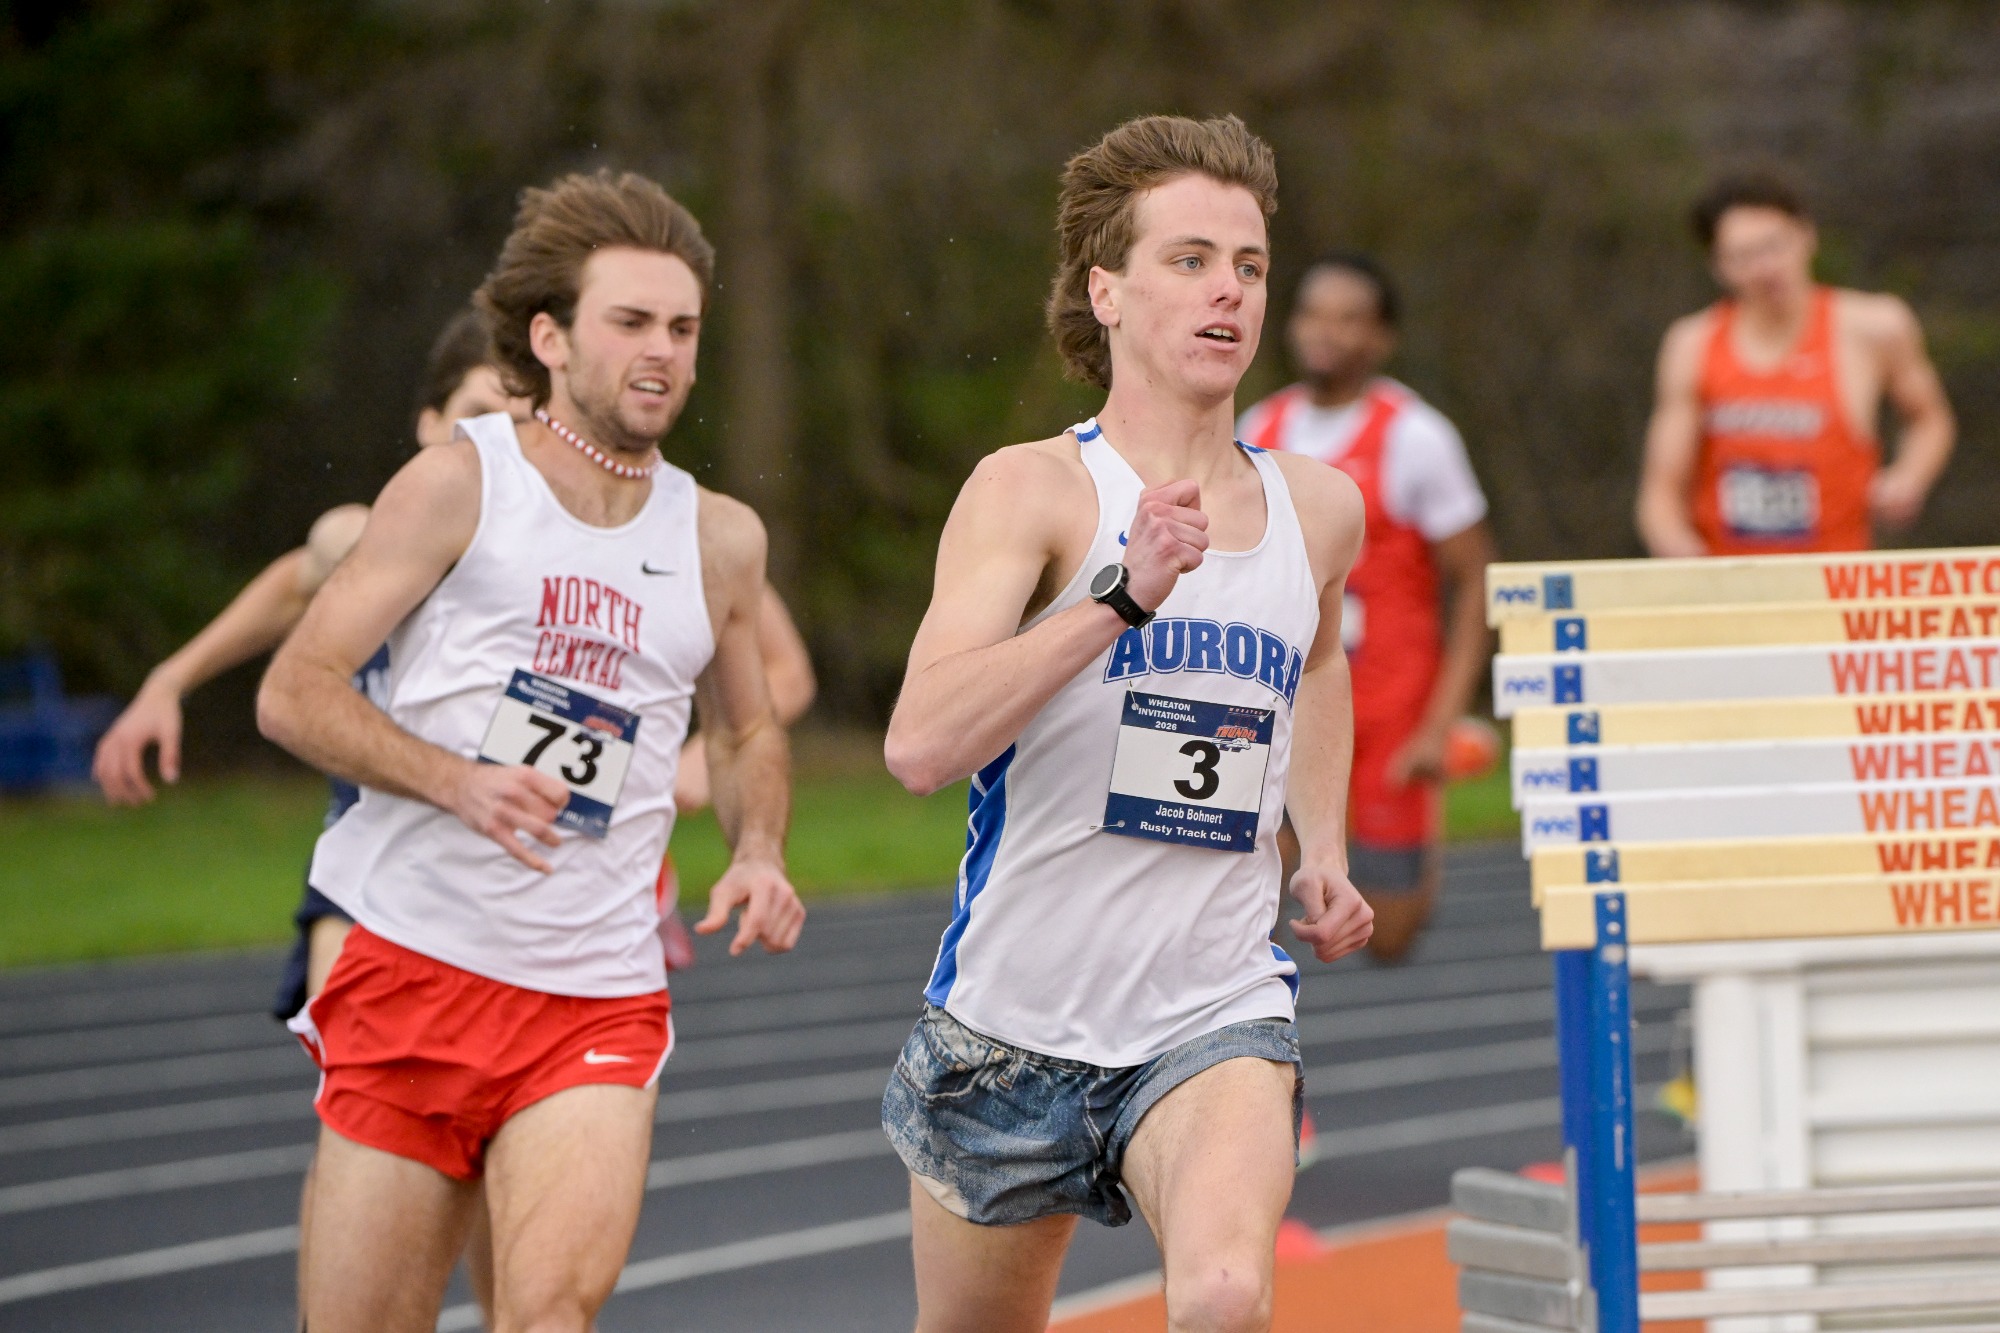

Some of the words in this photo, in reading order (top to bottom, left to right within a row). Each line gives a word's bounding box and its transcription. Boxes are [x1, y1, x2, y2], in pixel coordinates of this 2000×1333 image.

[536, 576, 643, 654] NORTH
[532, 630, 628, 691] CENTRAL
[1103, 617, 1303, 716] AURORA
[1830, 648, 1998, 694] WHEAT
[1138, 707, 1196, 723] INVITATIONAL
[1148, 698, 1191, 711] WHEATON
[1155, 720, 1177, 731] 2026
[521, 714, 605, 786] 73
[1173, 739, 1221, 801] 3
[1139, 821, 1172, 837] Rusty
[1176, 826, 1208, 840] Track
[1210, 830, 1232, 842] Club
[1155, 804, 1184, 820] Jacob
[1186, 808, 1223, 825] Bohnert
[1858, 788, 2000, 832] WHEA
